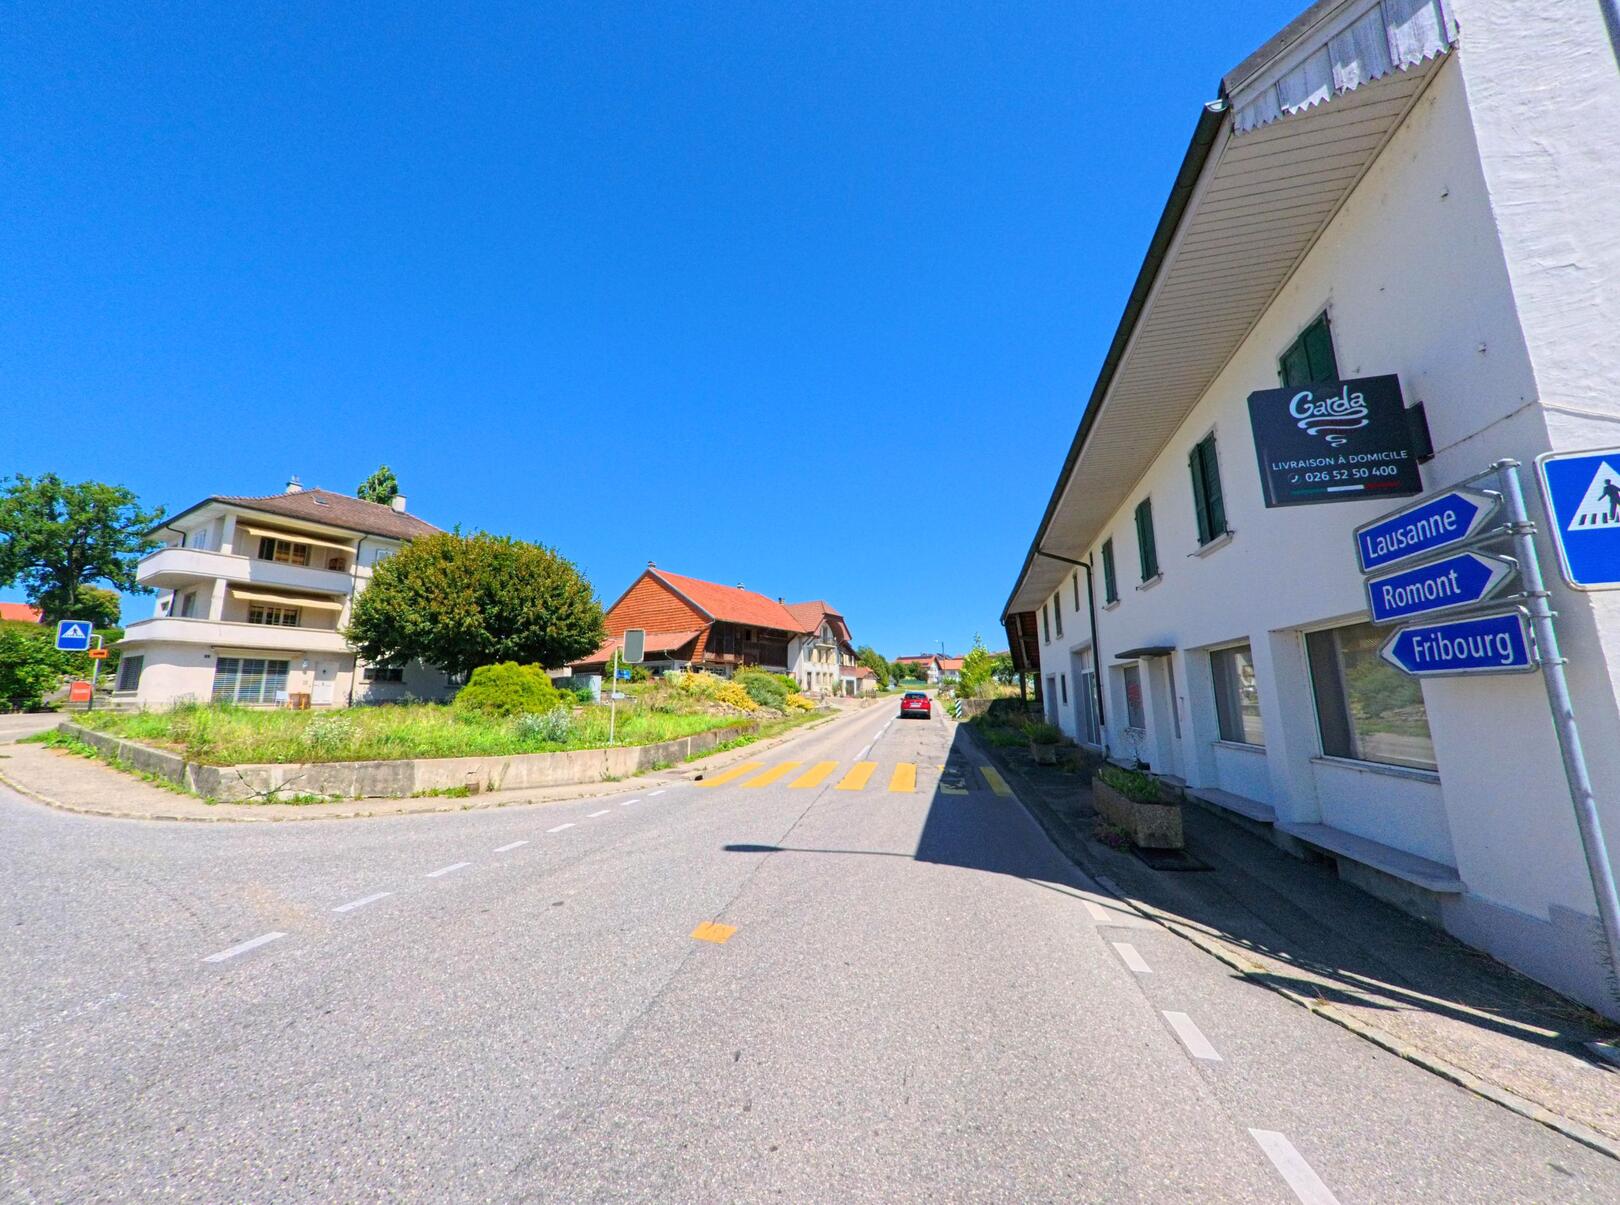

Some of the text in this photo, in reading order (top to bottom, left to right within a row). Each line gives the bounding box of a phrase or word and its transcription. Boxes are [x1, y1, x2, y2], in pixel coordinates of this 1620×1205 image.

[1289, 385, 1367, 419] Garda
[1272, 450, 1408, 471] LIVRAISON À DOMICILE
[1305, 465, 1397, 482] 026 52 50 400
[1366, 509, 1457, 558] Lausanne
[1383, 569, 1460, 610] Romont
[1412, 631, 1514, 663] Fribourg
